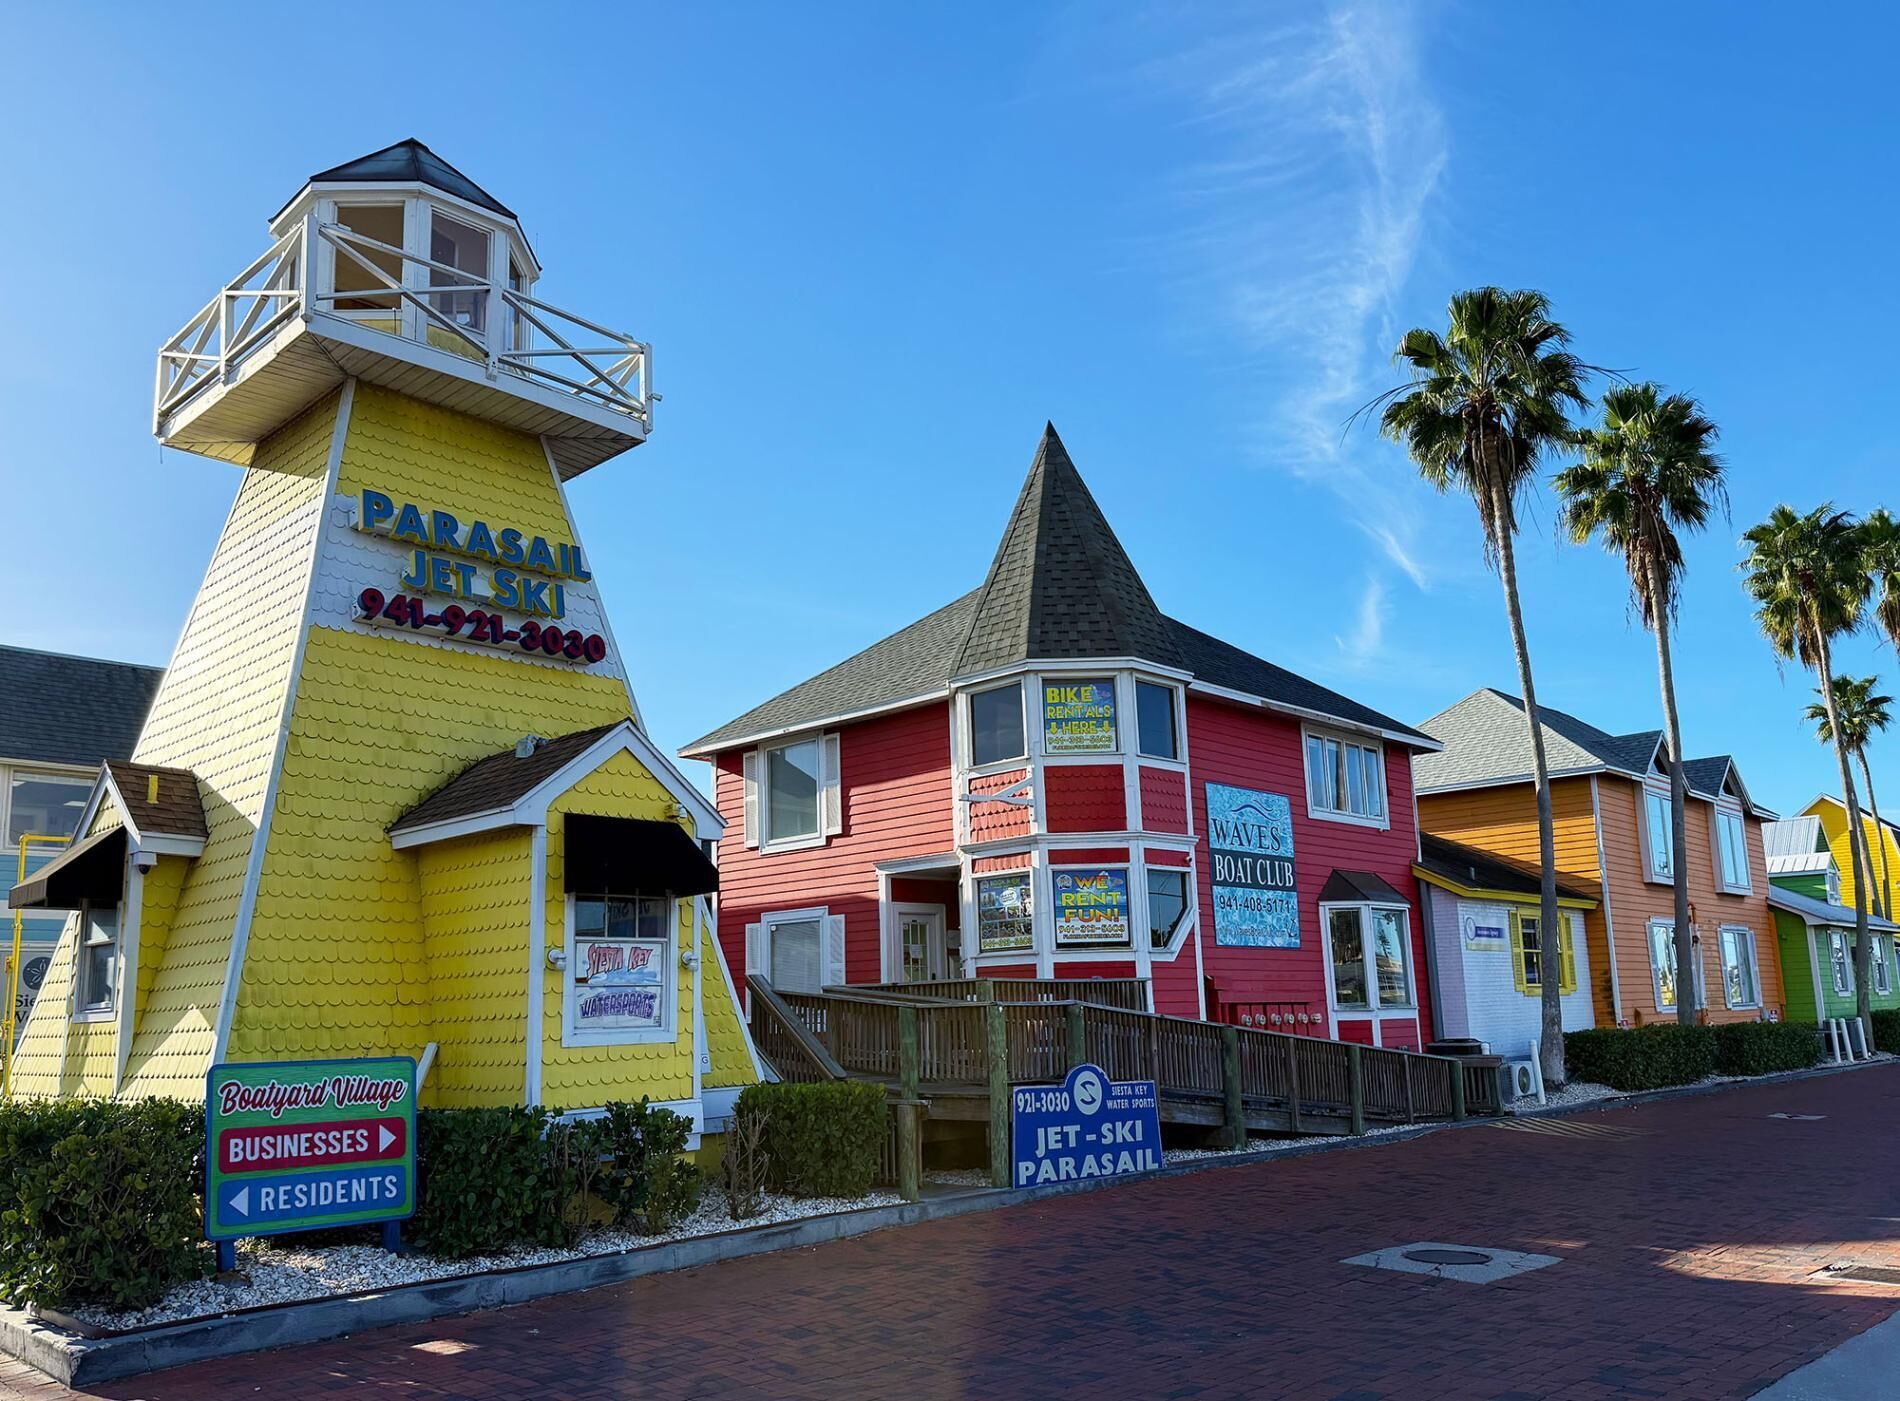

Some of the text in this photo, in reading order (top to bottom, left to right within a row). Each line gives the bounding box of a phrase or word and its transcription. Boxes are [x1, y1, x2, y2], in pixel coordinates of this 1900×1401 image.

[359, 489, 592, 583] PARASAIL
[401, 550, 566, 620] JET SKI
[357, 587, 607, 664] 941-921-3030
[1046, 686, 1093, 704] BIKE
[1046, 705, 1112, 719] RENTALS
[1062, 721, 1097, 735] HERE
[1211, 818, 1281, 851] WAVES
[1073, 874, 1109, 889] WE
[1214, 854, 1294, 887] BOAT CLUB
[1061, 892, 1121, 907] RENT
[1219, 894, 1291, 914] 941-408-5171
[1064, 908, 1120, 923] FUN!
[587, 944, 654, 980] SIESTA KEY
[580, 991, 658, 1020] WATERSPORTS
[218, 1075, 409, 1119] Boatyard Village
[1017, 1091, 1070, 1113] 921-3030
[1106, 1098, 1155, 1110] WATER SPORTS
[1111, 1085, 1148, 1096] SIESTA KEY
[229, 1128, 369, 1163] BUSINESSES
[1018, 1148, 1159, 1185] PARASAIL
[260, 1175, 398, 1211] RESIDENTS
